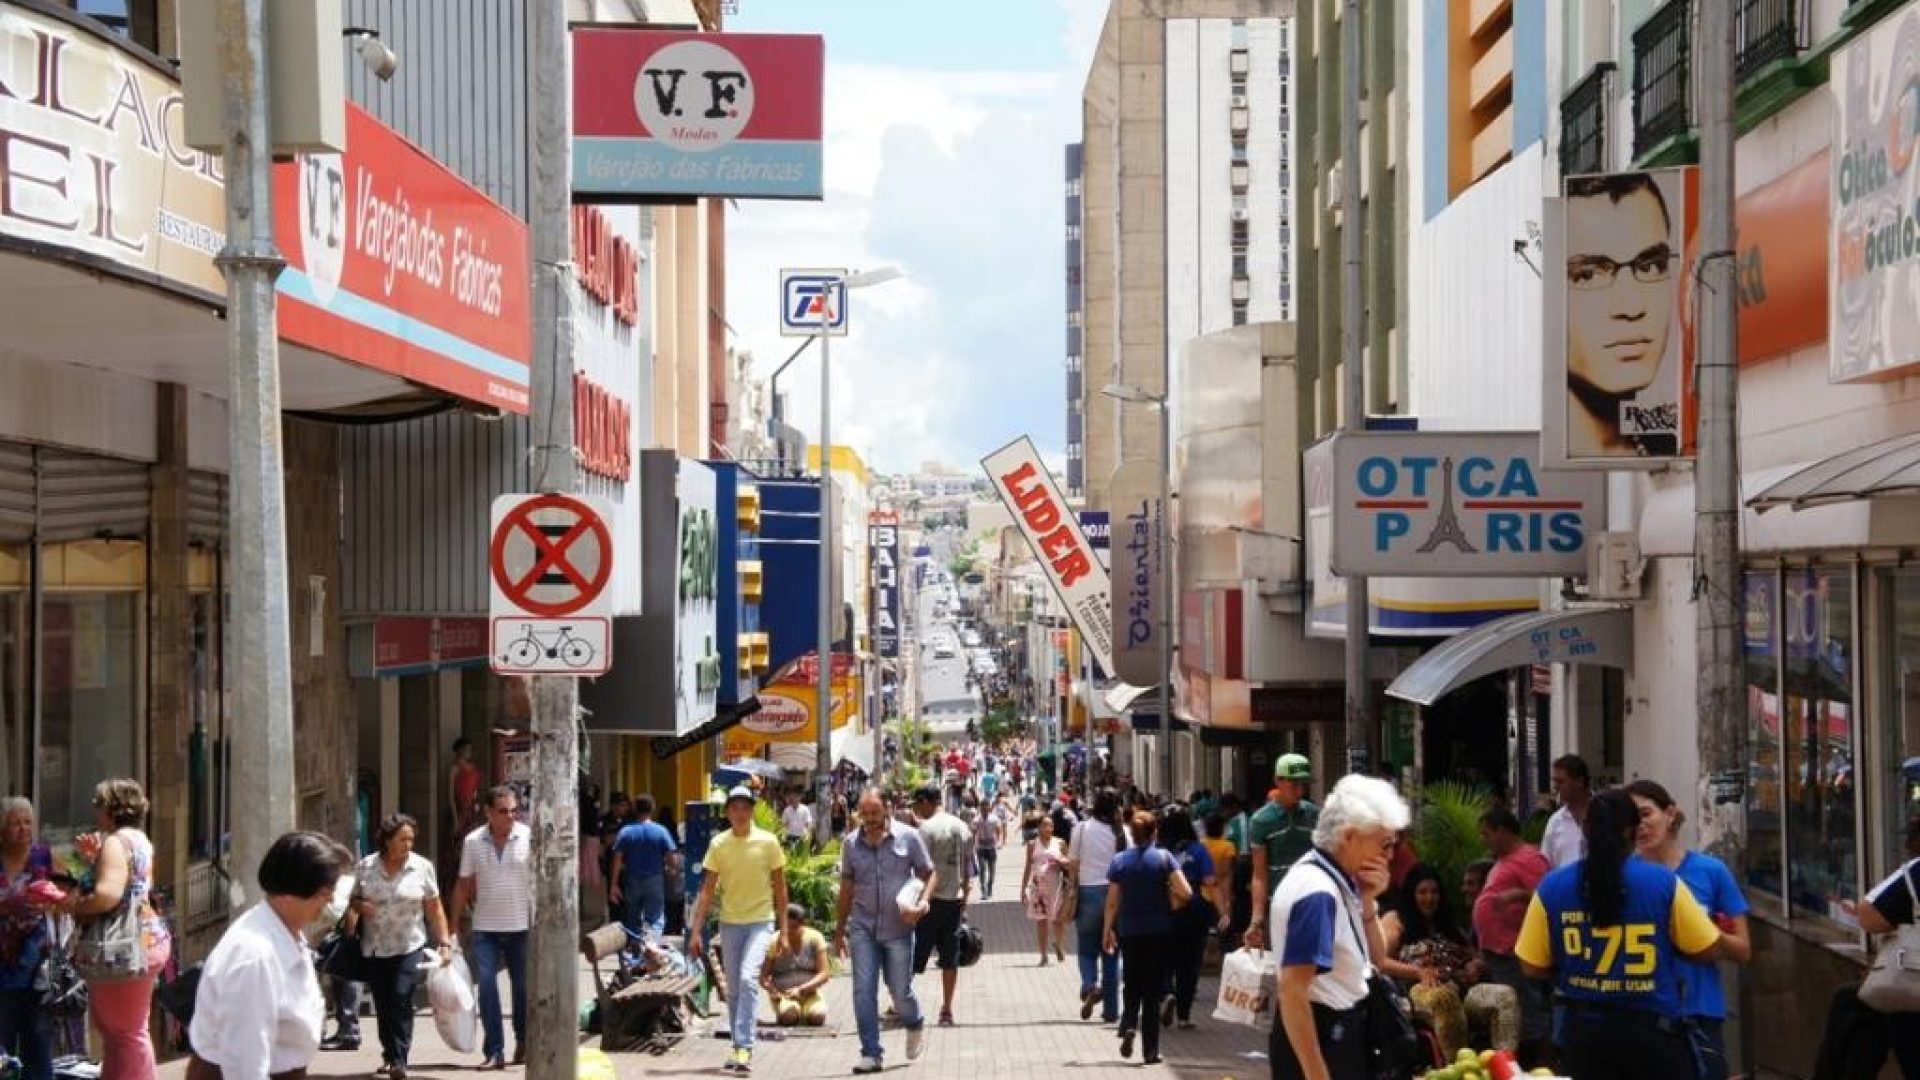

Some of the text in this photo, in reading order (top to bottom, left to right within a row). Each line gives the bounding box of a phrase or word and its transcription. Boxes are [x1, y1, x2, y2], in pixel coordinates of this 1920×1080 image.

[670, 126, 719, 143] Modas
[586, 152, 664, 185] Varejão
[670, 152, 711, 179] das
[1002, 462, 1091, 588] LIDER
[870, 528, 896, 629] BAHIA
[1563, 923, 1657, 976] 0,75
